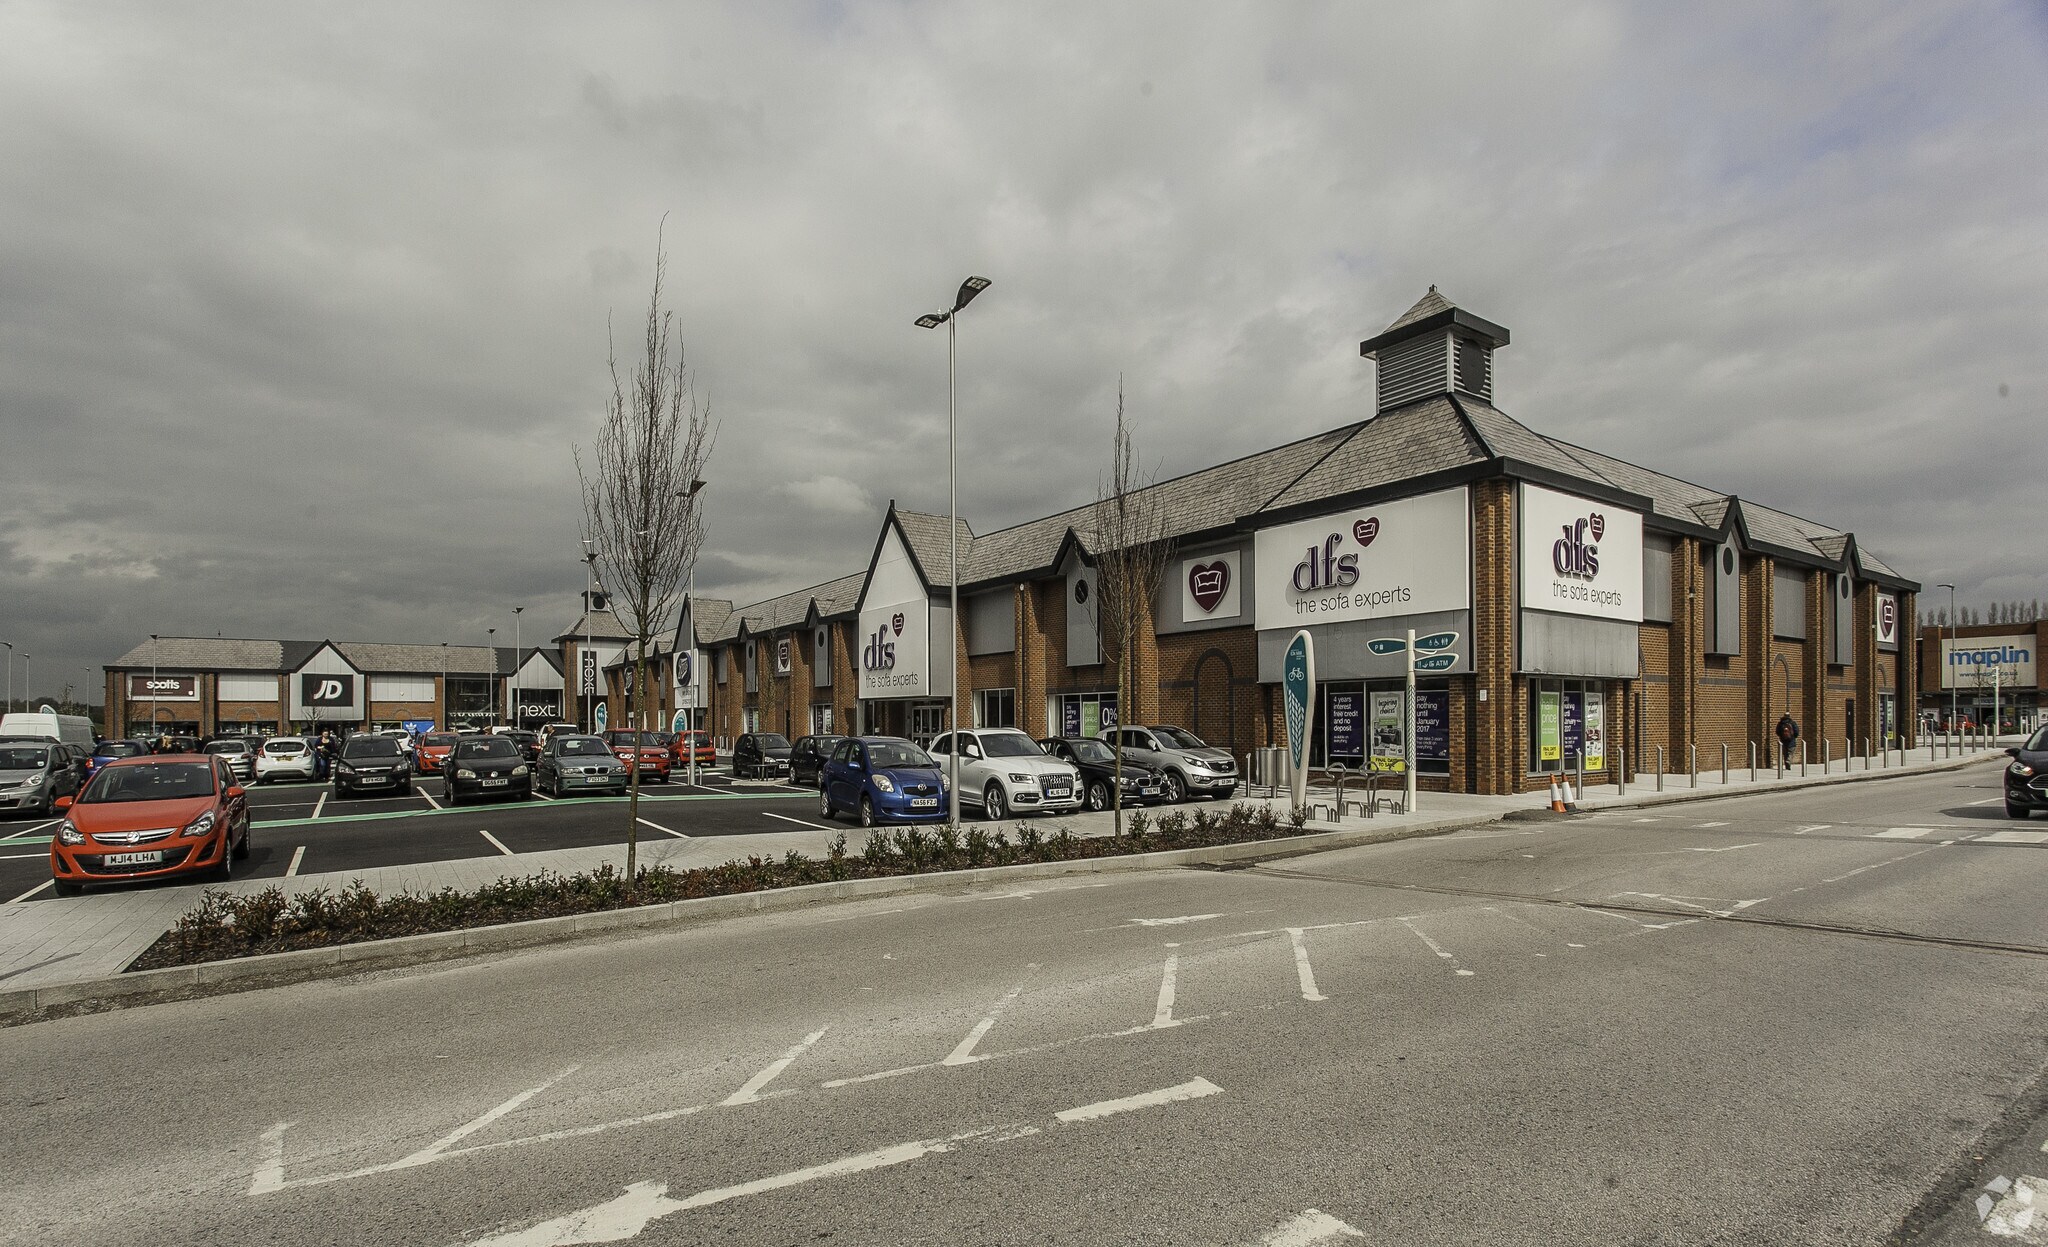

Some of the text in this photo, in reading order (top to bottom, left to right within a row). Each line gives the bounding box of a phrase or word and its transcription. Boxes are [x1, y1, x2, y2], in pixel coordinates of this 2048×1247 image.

[1553, 518, 1599, 577] dfs
[1293, 532, 1360, 592] dfs
[1296, 586, 1411, 614] the sofa experts
[1553, 580, 1621, 607] the sofa experts
[864, 624, 895, 671] dfs
[1949, 646, 2029, 667] maplin
[146, 679, 180, 689] scotts
[313, 680, 342, 699] JD
[865, 672, 918, 689] the sofa experts
[518, 704, 556, 716] next
[1417, 702, 1437, 710] nothing
[1103, 707, 1117, 726] 0%
[1417, 718, 1439, 726] January
[110, 853, 155, 864] MJ14 LHA
